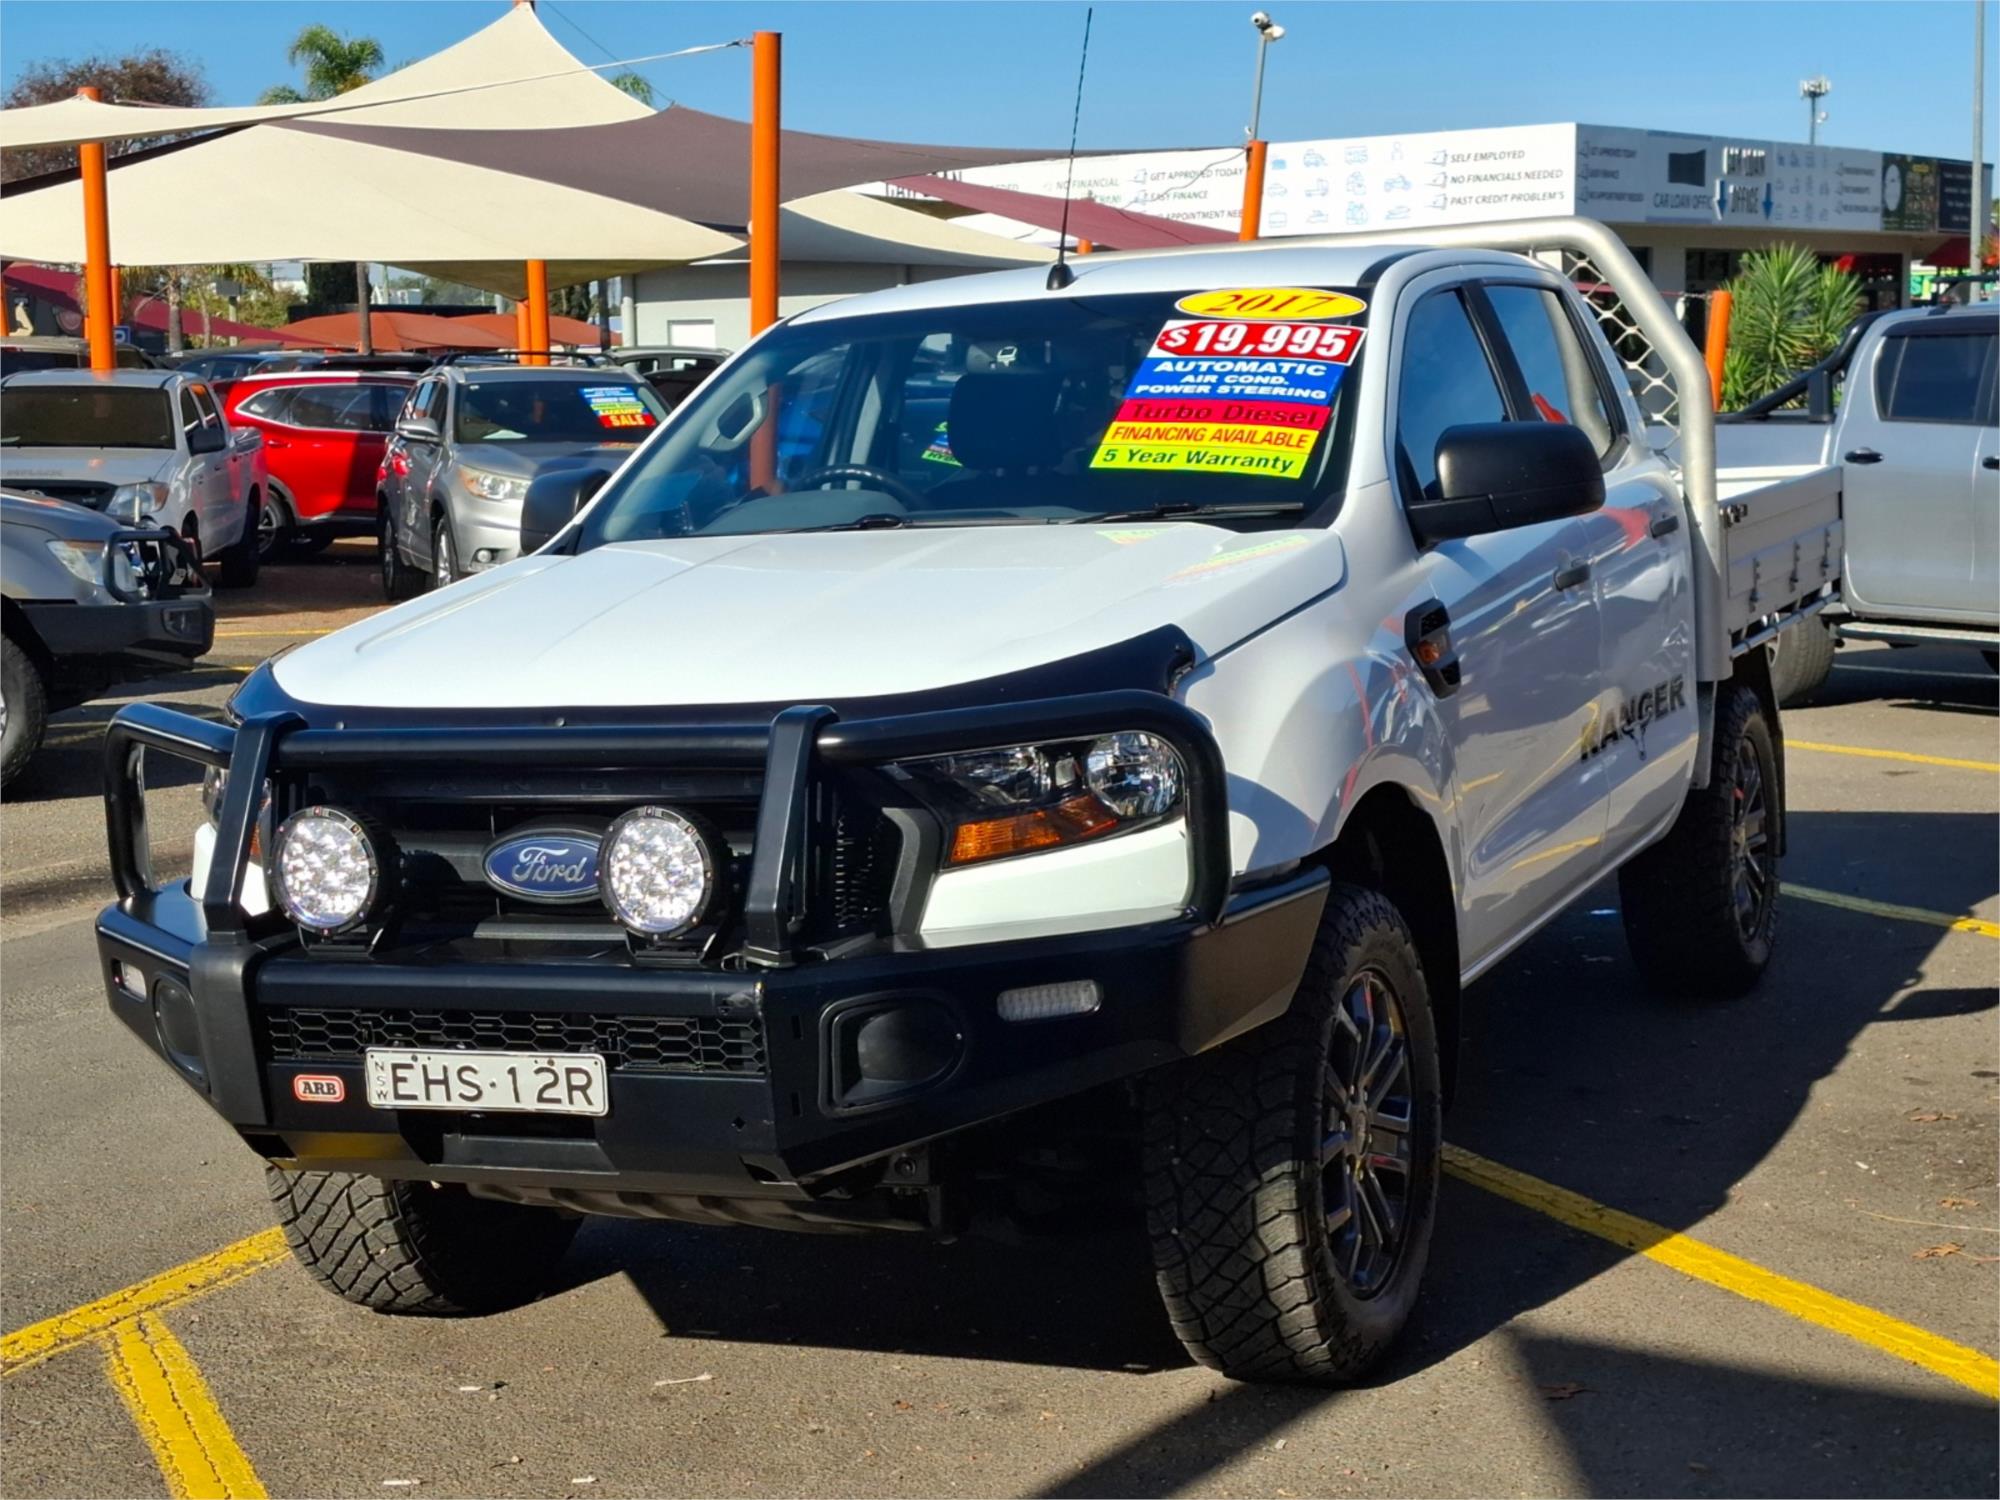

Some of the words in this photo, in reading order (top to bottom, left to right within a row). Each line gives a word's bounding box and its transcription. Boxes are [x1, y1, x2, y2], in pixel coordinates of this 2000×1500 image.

[1450, 152, 1472, 163] SELF
[1473, 150, 1525, 161] EMPLOYED
[1150, 171, 1166, 181] GET
[1168, 169, 1213, 180] APPROVED
[1215, 167, 1244, 178] TODAY
[1451, 175, 1465, 184] NO
[1467, 172, 1522, 183] FINANCIALS
[1524, 169, 1564, 180] NEEDED
[1072, 178, 1120, 188] FINANCIAL
[1173, 190, 1208, 200] FINANCE
[1450, 195, 1473, 206] PAST
[1475, 193, 1509, 205] CREDIT
[1166, 210, 1225, 220] APPOINTMENT
[1204, 293, 1341, 313] 2017
[1164, 322, 1351, 357] $19,995
[1153, 360, 1328, 377] AUTOMATIC
[1180, 374, 1219, 384] AIR
[1223, 374, 1290, 386] COND.
[1135, 384, 1212, 395] POWER
[1215, 386, 1327, 400] STEERING
[609, 414, 646, 427] SALE
[1131, 403, 1213, 420] Turbo
[1222, 404, 1319, 426] Diesel
[1111, 426, 1207, 442] FINANCING
[1208, 427, 1310, 449] AVAILABLE
[1102, 448, 1117, 463] 5
[1126, 448, 1177, 465] Year
[1185, 450, 1295, 473] Warranty
[511, 846, 588, 883] Ford
[301, 1080, 338, 1096] ARB
